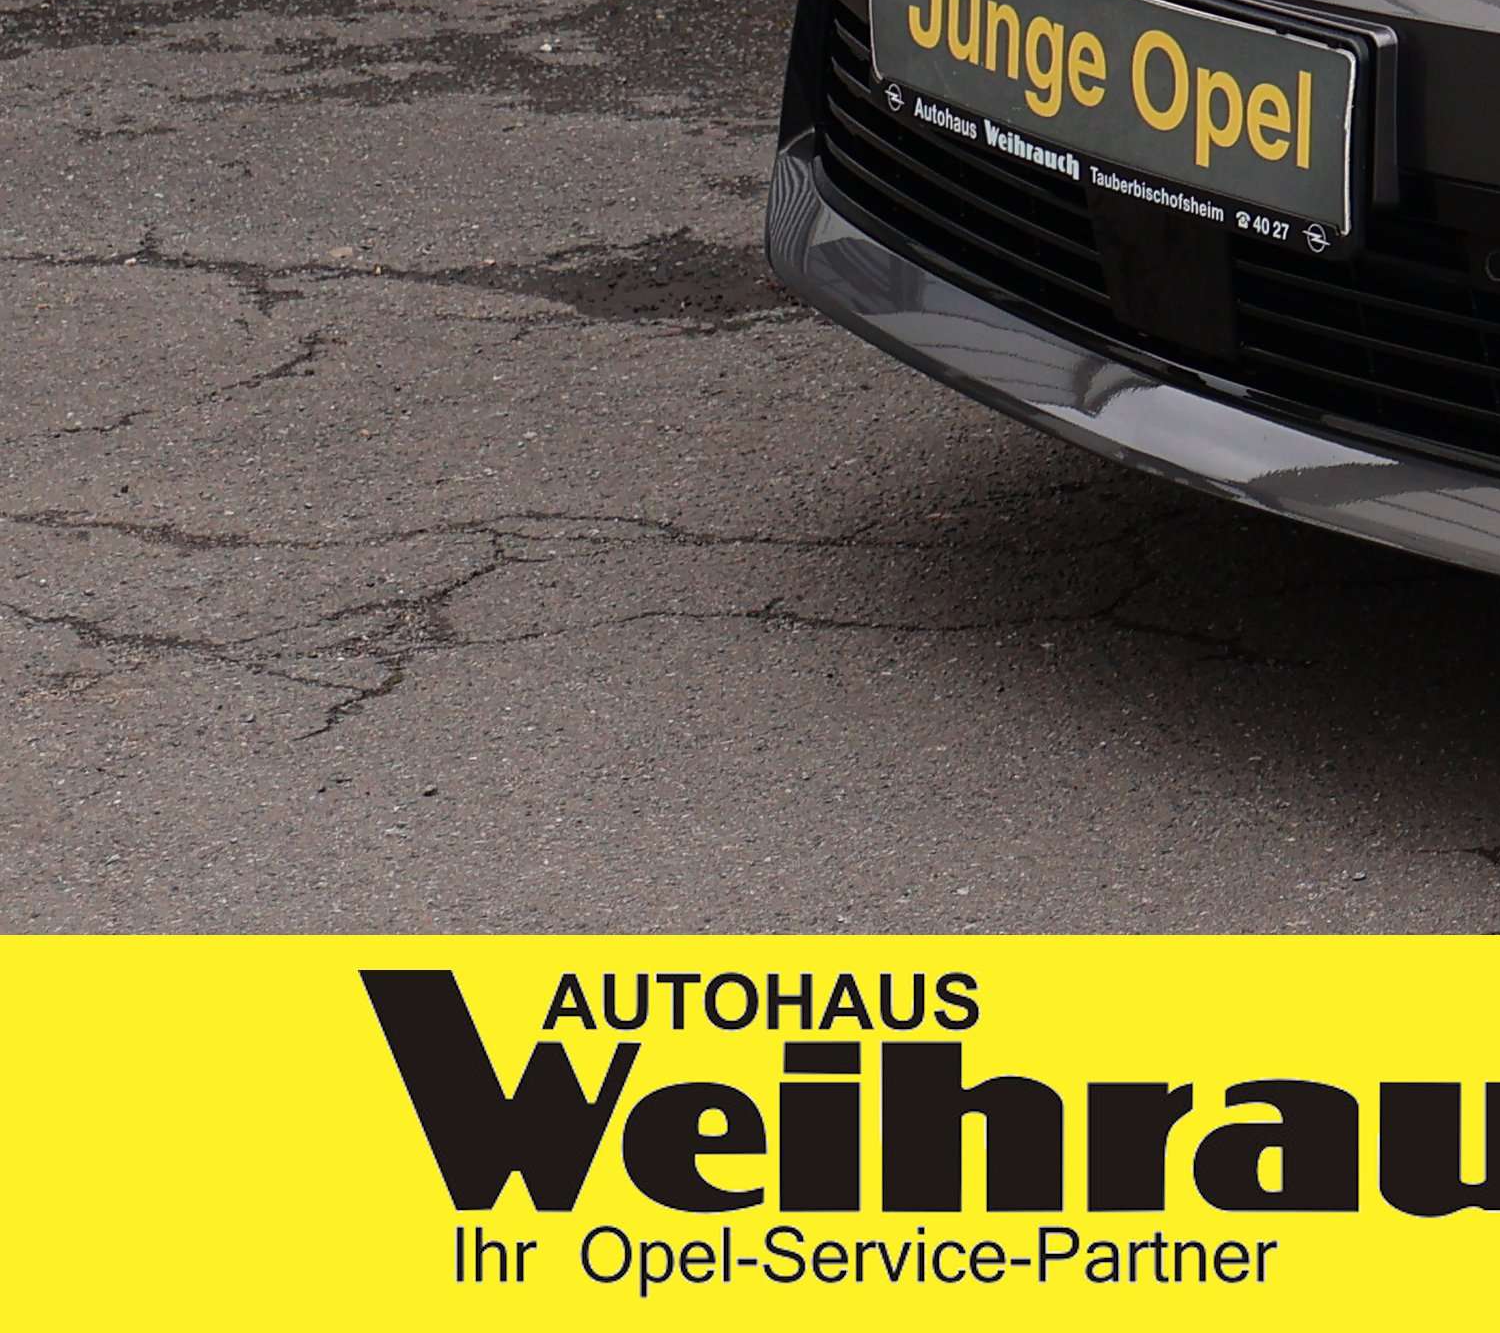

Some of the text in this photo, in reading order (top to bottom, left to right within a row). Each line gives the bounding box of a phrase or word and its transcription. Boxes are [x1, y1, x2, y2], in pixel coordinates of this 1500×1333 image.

[914, 97, 1290, 241] Autohaus Weihrauch Tauberbischofsheim 40 27
[1131, 29, 1313, 170] Opel
